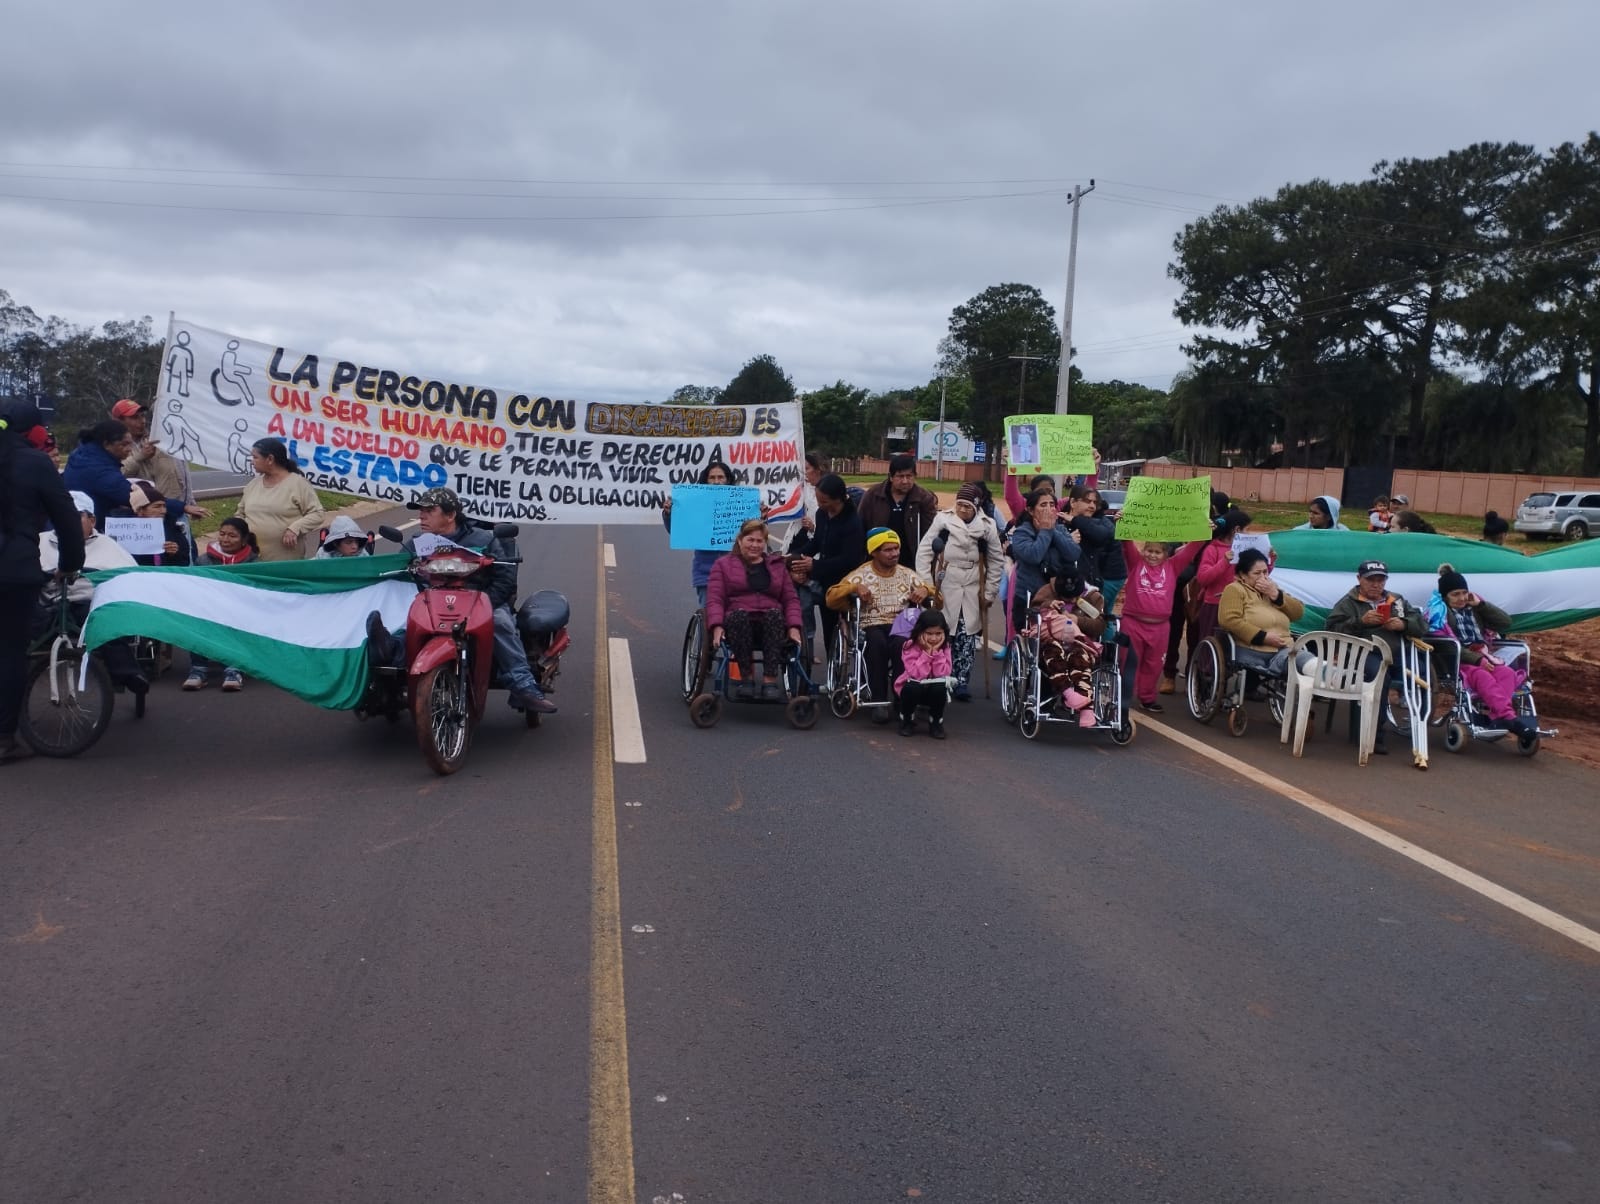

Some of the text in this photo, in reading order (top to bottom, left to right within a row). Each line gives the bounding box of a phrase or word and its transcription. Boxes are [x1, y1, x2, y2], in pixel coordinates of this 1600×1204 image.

[268, 347, 782, 436] LA PERSONA CON DISCAPACIDAD ES
[270, 384, 312, 413] UN
[320, 396, 371, 427] SER
[600, 441, 705, 465] DERECHO
[708, 443, 723, 464] A
[729, 440, 799, 465] VIVIENDA
[267, 413, 287, 437] A
[292, 418, 325, 445] UN
[331, 426, 420, 460] SUELDO
[429, 444, 472, 467] QUE
[479, 452, 502, 472] LE
[510, 455, 603, 480] PERMITA
[609, 465, 664, 484] VIVIR
[754, 464, 801, 485] DIGNA
[313, 446, 448, 488] ESTADO
[454, 473, 511, 498] TIENE
[519, 481, 543, 501] LA
[549, 485, 666, 509] OBLIGACION
[768, 488, 786, 506] DE
[358, 481, 371, 496] A
[376, 484, 404, 501] LOS
